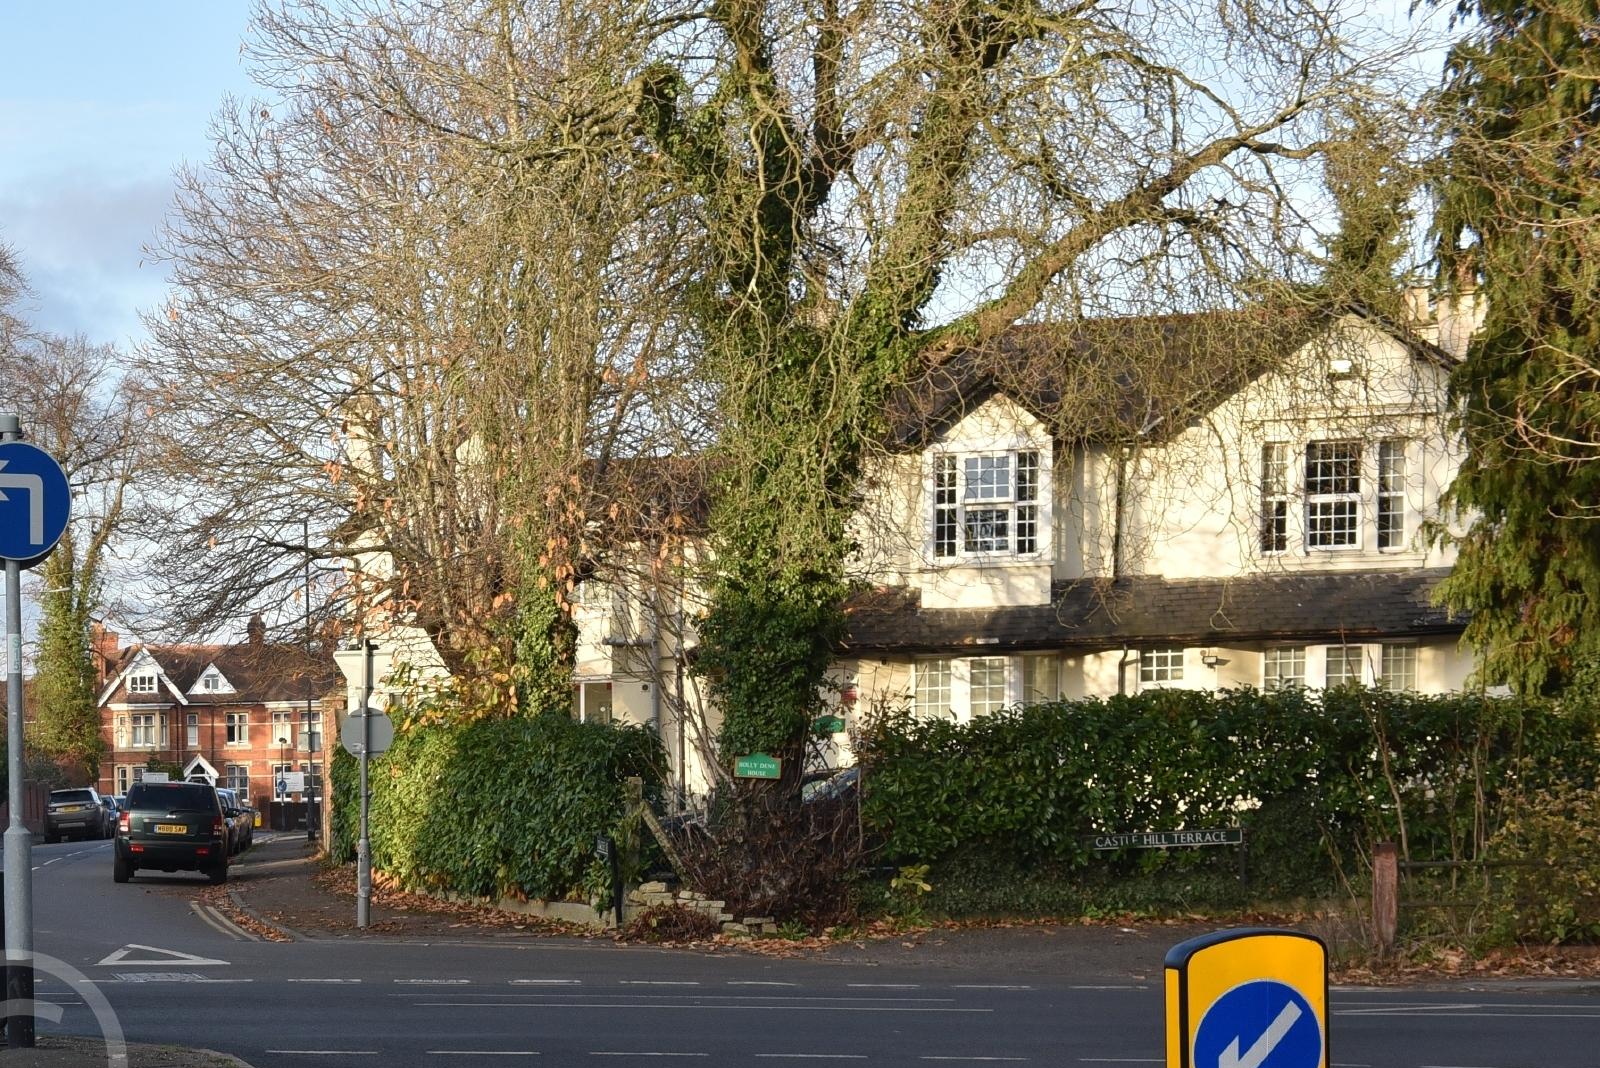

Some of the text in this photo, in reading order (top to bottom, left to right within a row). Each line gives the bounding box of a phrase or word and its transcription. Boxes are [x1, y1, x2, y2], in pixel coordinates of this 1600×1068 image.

[747, 769, 767, 777] HOUSE
[1095, 831, 1227, 848] CASTLE HILL TERRACE
